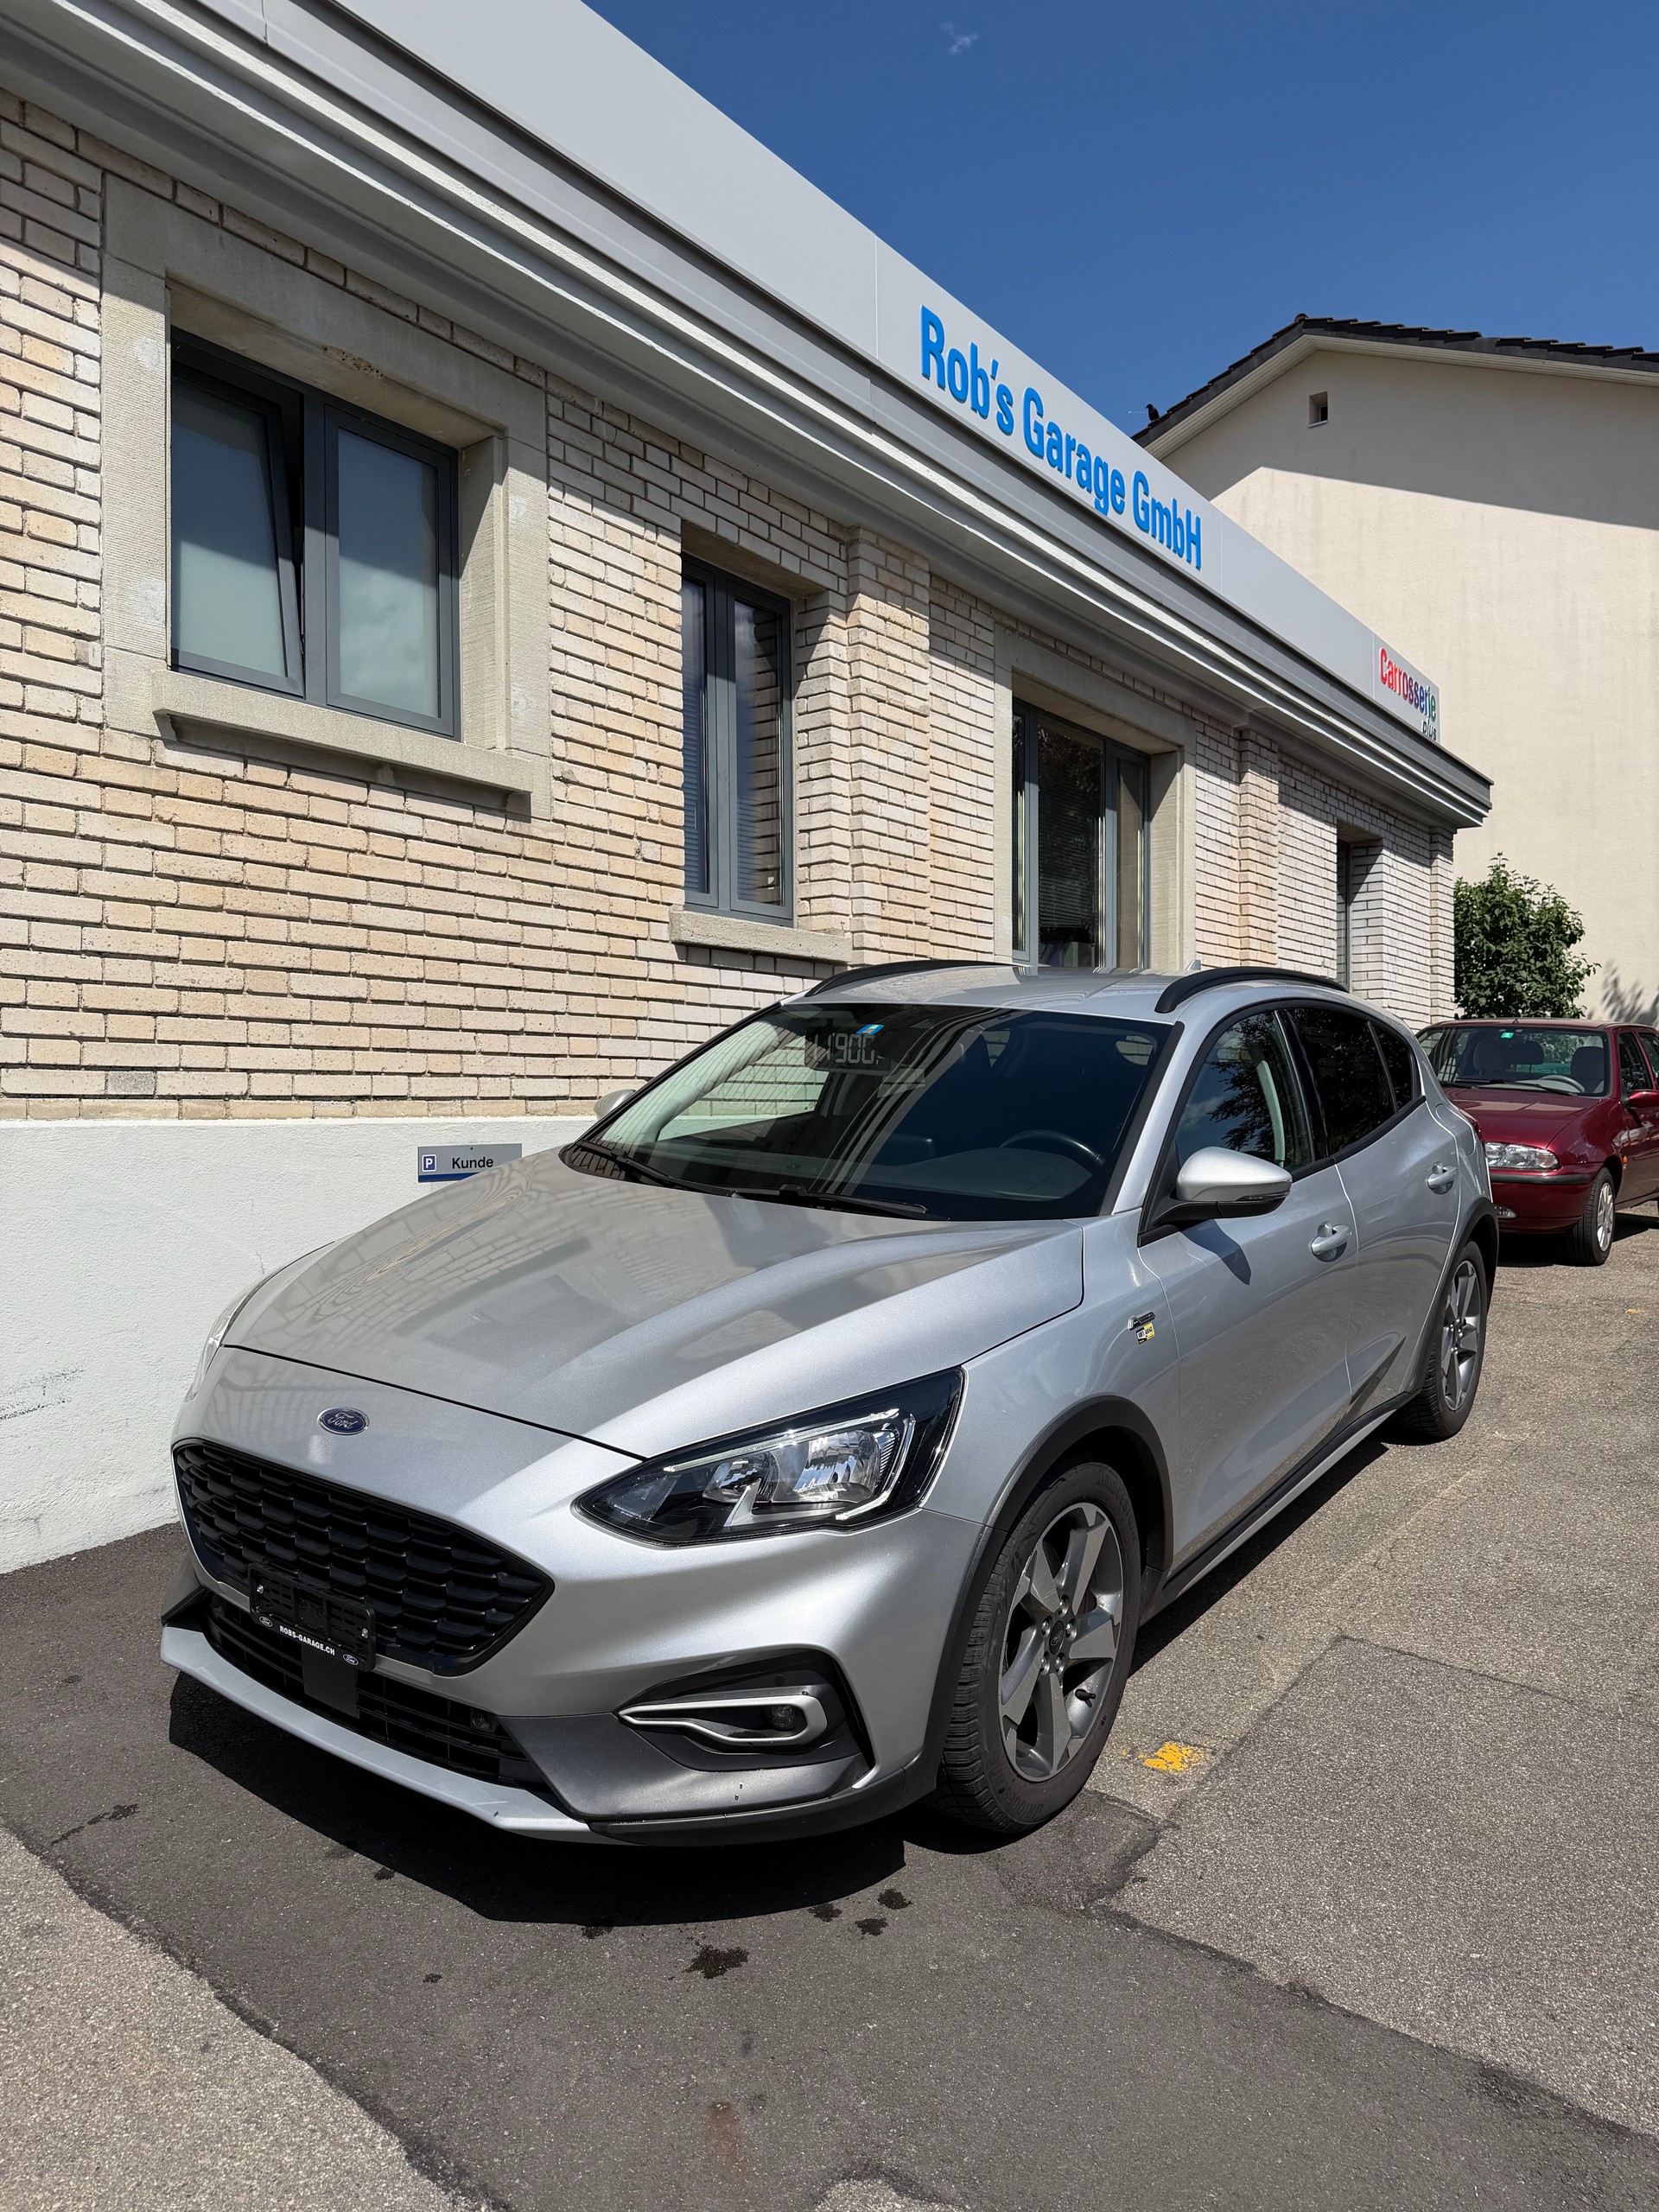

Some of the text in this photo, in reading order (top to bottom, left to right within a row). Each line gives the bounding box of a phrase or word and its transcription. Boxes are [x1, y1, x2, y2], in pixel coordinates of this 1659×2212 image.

[919, 304, 1202, 570] Rob's Garage GmbH
[1380, 647, 1436, 722] Carrosserie
[1421, 718, 1437, 741] plus
[452, 1156, 494, 1169] Kunde
[279, 1624, 335, 1656] ROBS-GARAGE.CH
